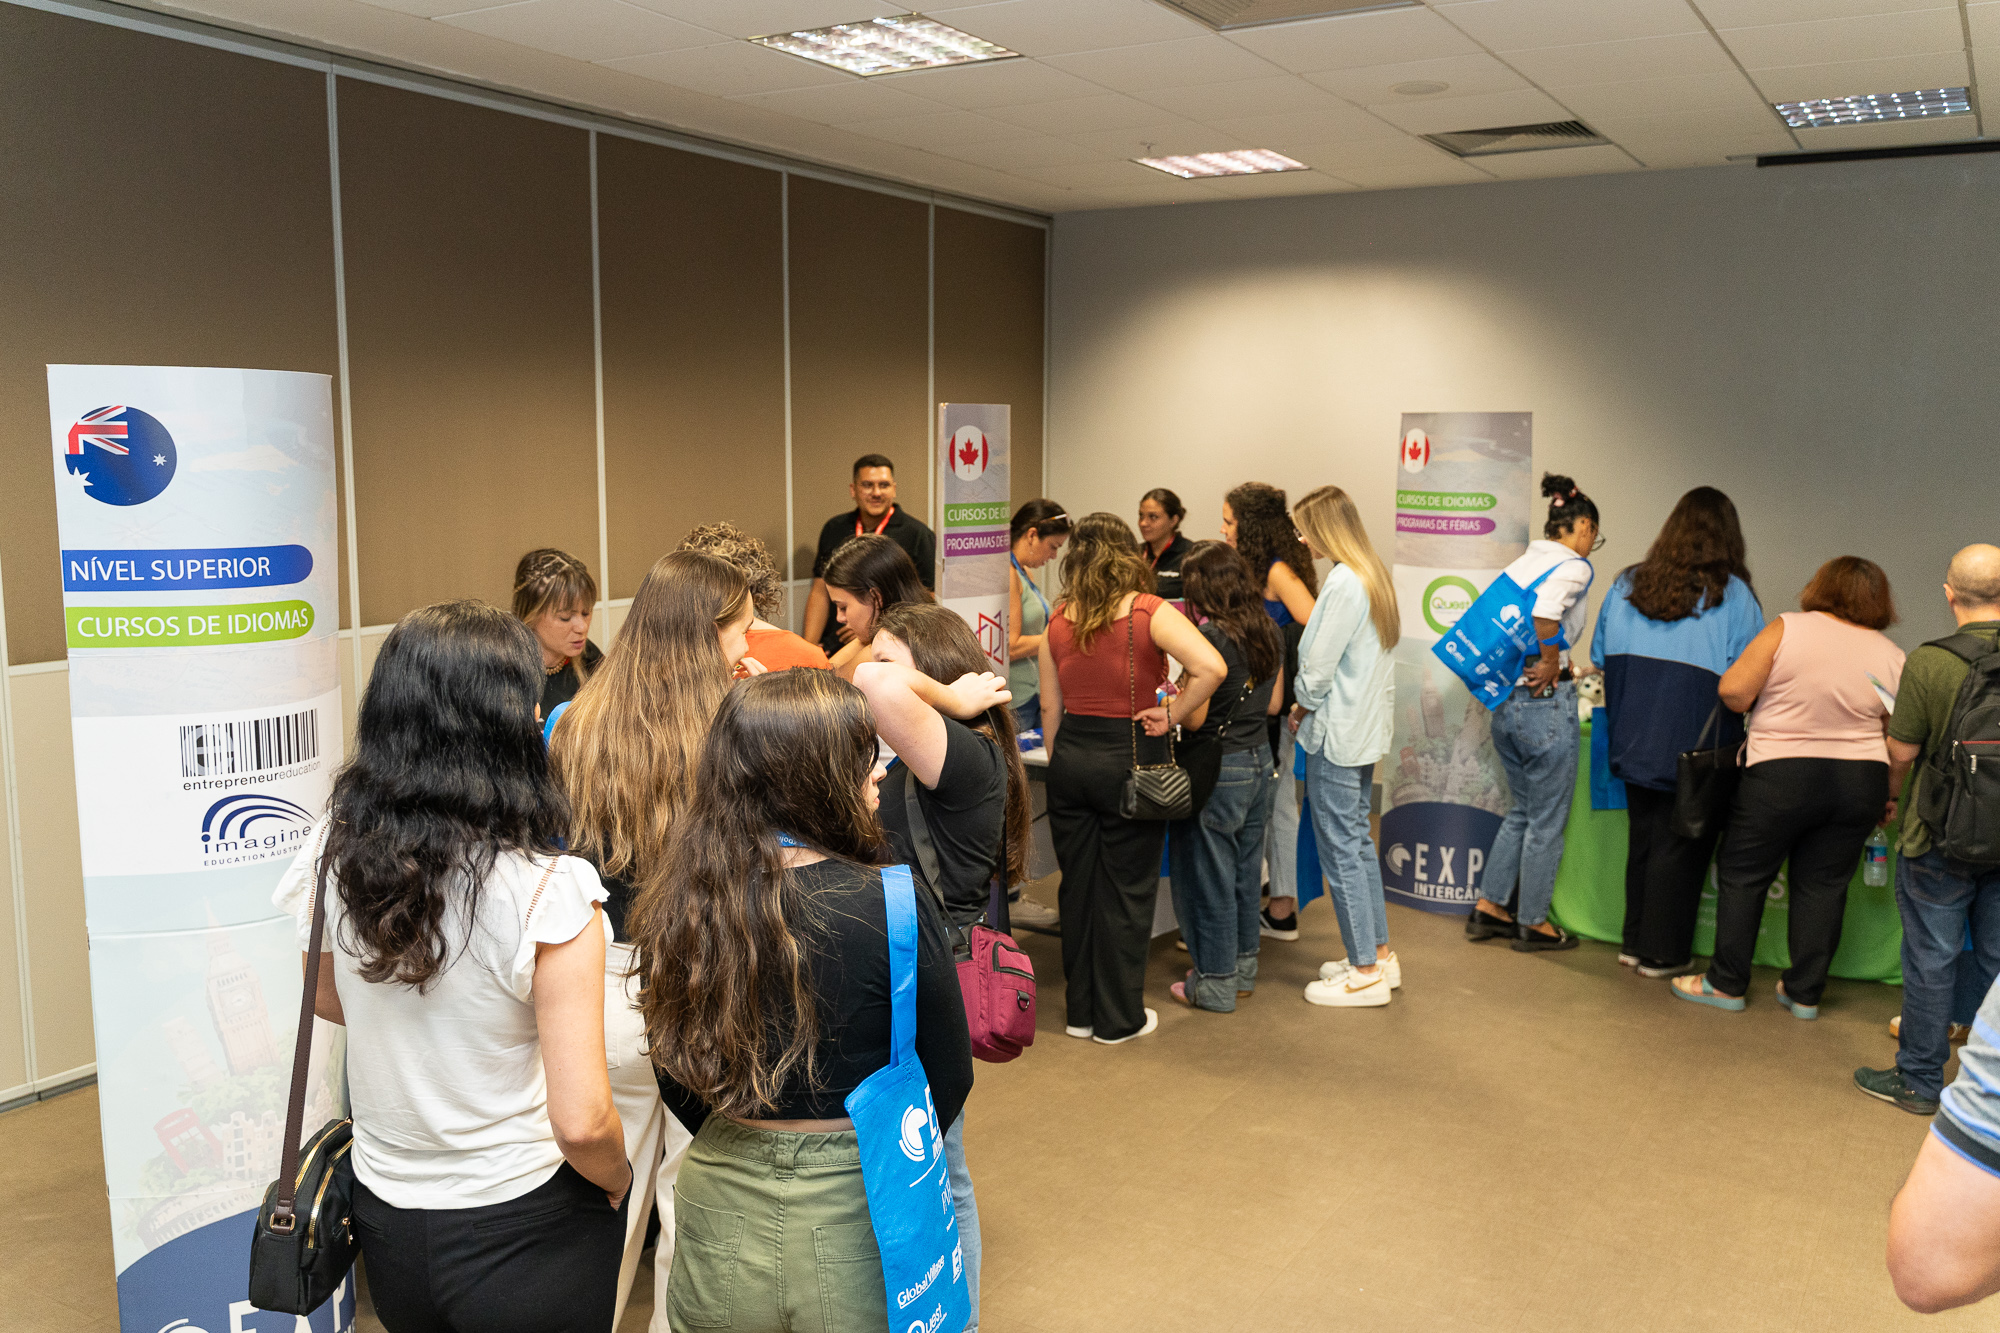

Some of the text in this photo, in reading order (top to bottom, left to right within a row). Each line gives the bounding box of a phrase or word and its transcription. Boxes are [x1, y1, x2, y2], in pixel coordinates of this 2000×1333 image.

[1397, 493, 1490, 508] CURSOS DE IDIOMAS
[947, 508, 987, 521] CURSOS
[988, 507, 1000, 520] DE
[1397, 516, 1481, 532] PROGRAMAS DE FÉRIAS
[946, 535, 996, 550] PROGRAMAS
[996, 534, 1004, 548] DE
[71, 556, 271, 582] NÍVEL SUPERIOR
[77, 607, 309, 638] CURSOS DE IDIOMAS
[183, 760, 321, 790] entrepreneureducation
[201, 825, 312, 854] imagine
[203, 853, 266, 867] EDUCATION
[1414, 842, 1484, 885] EXP
